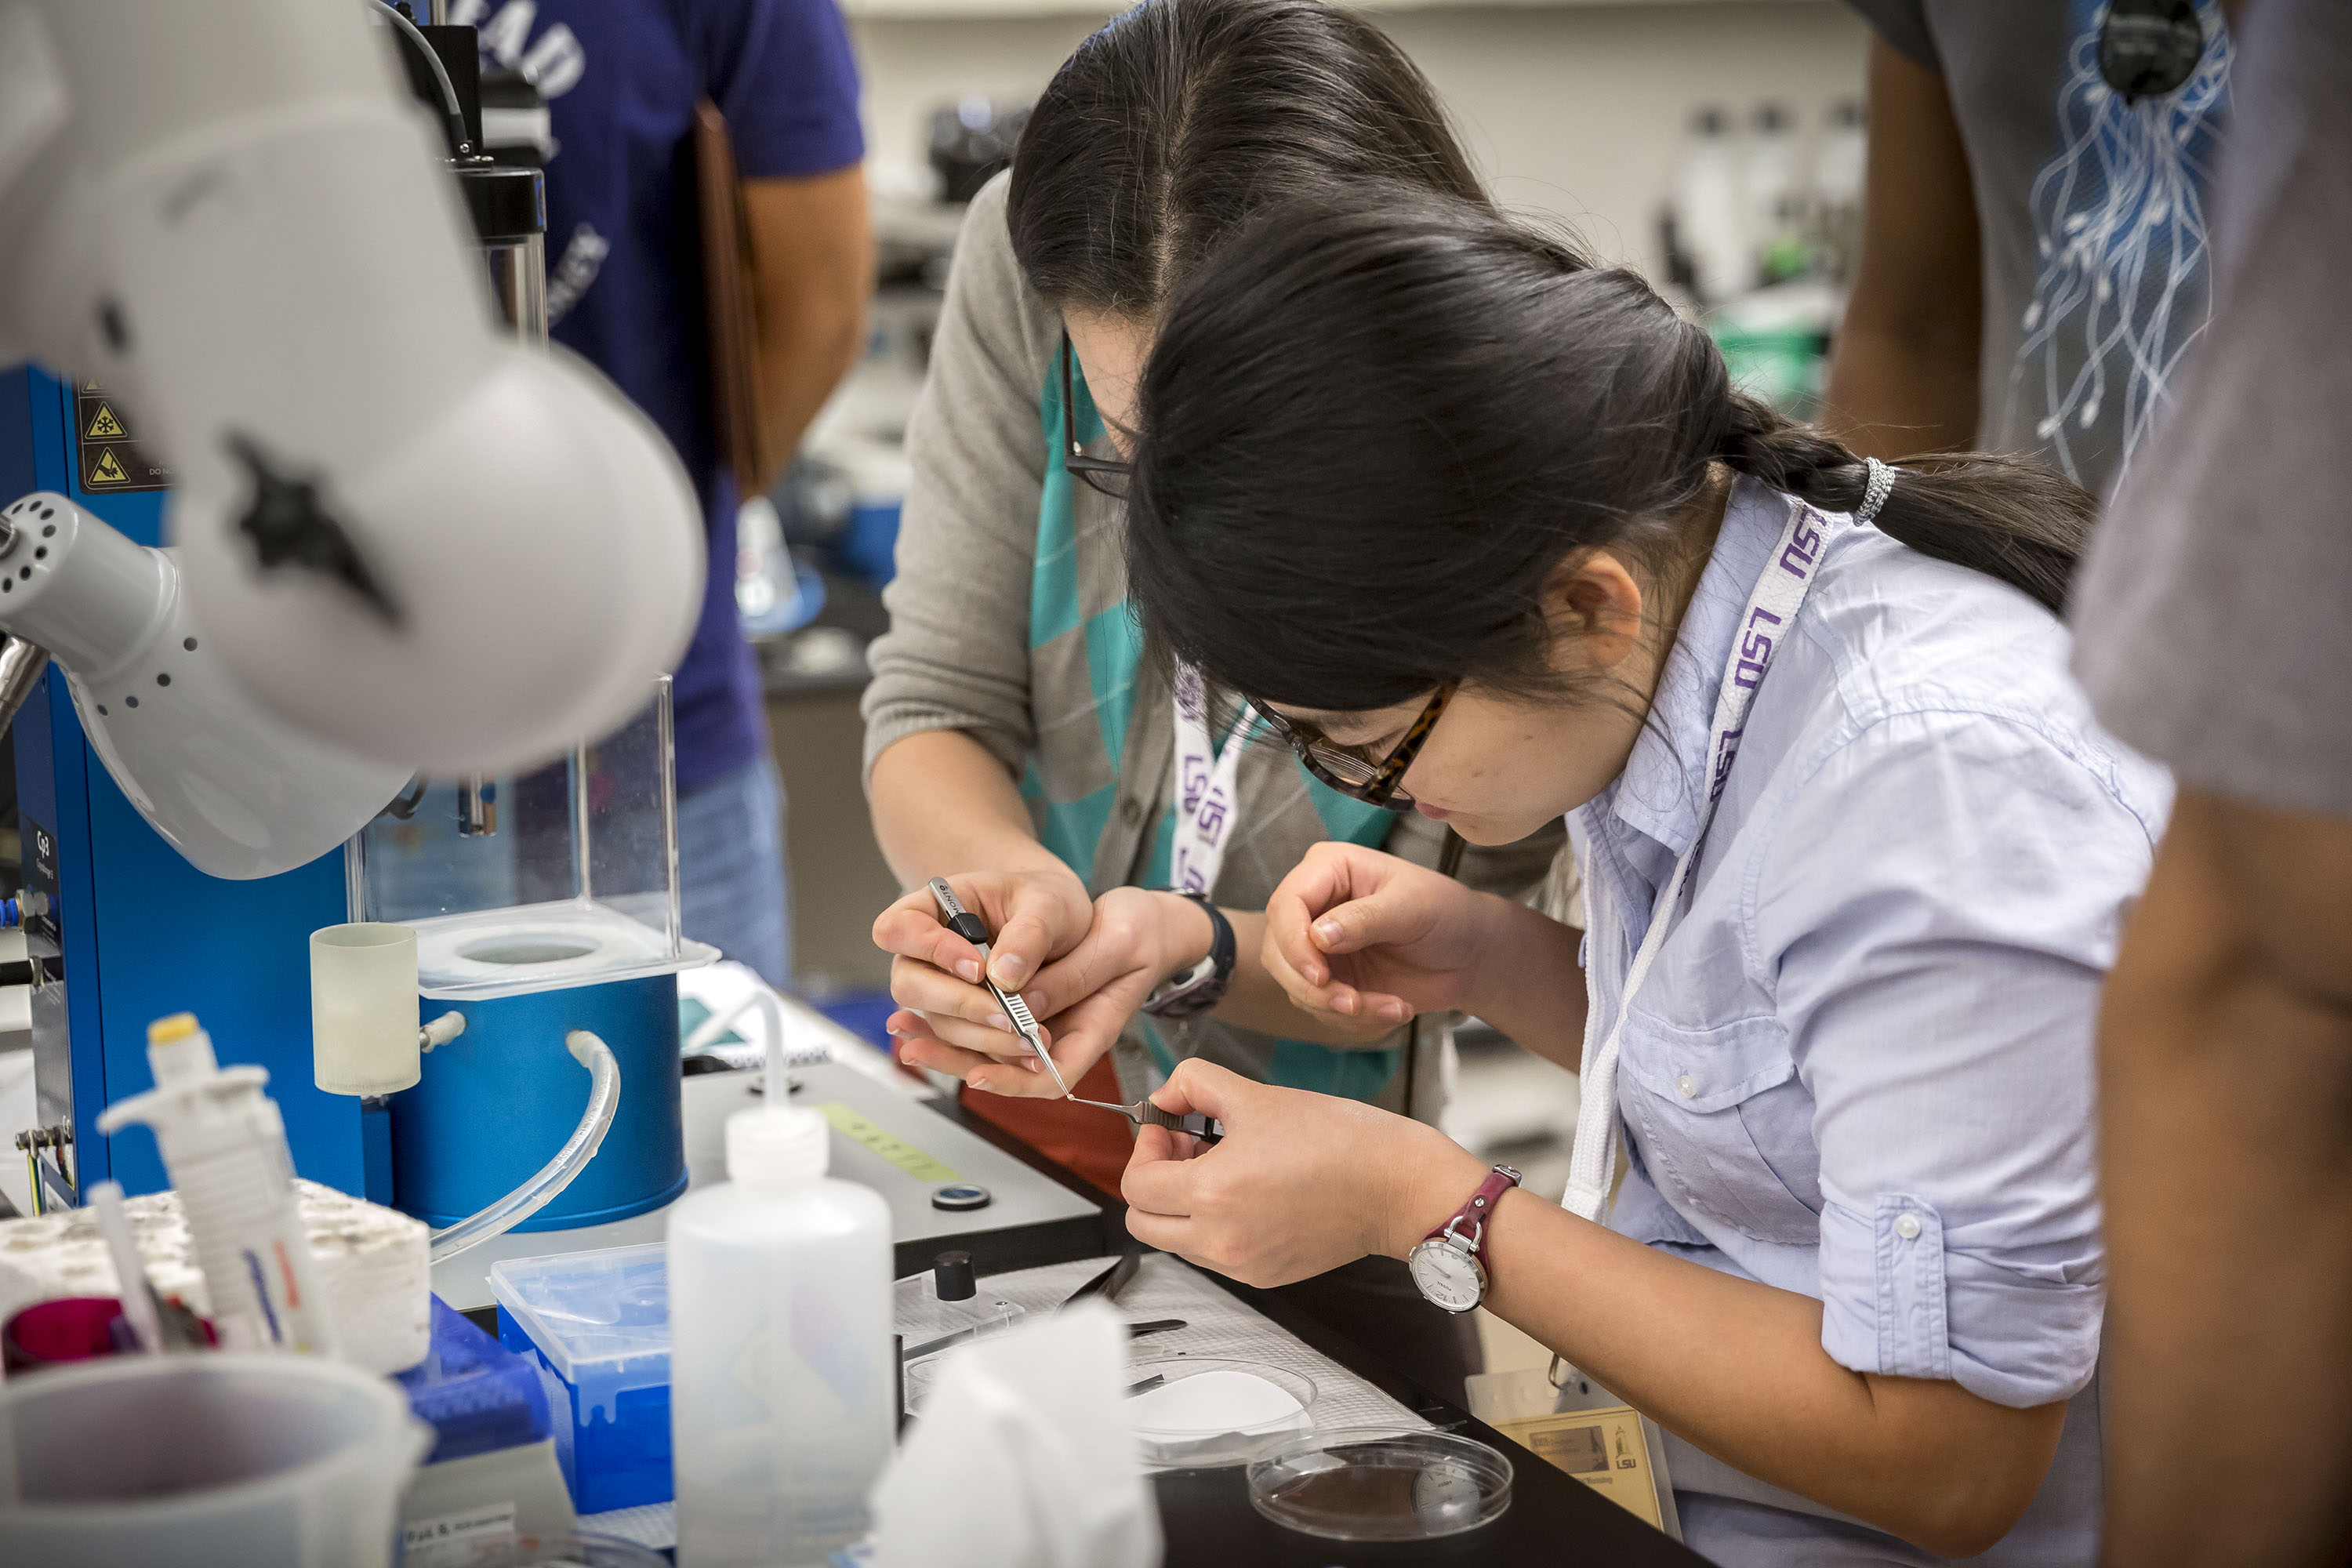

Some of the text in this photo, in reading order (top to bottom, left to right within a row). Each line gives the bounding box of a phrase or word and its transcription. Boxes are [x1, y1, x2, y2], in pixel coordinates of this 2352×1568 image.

[1780, 504, 1828, 579] LSU
[1734, 607, 1781, 689] LSU
[1710, 728, 1742, 803] LSU
[1435, 1290, 1447, 1301] 12
[1616, 1459, 1637, 1469] LSU
